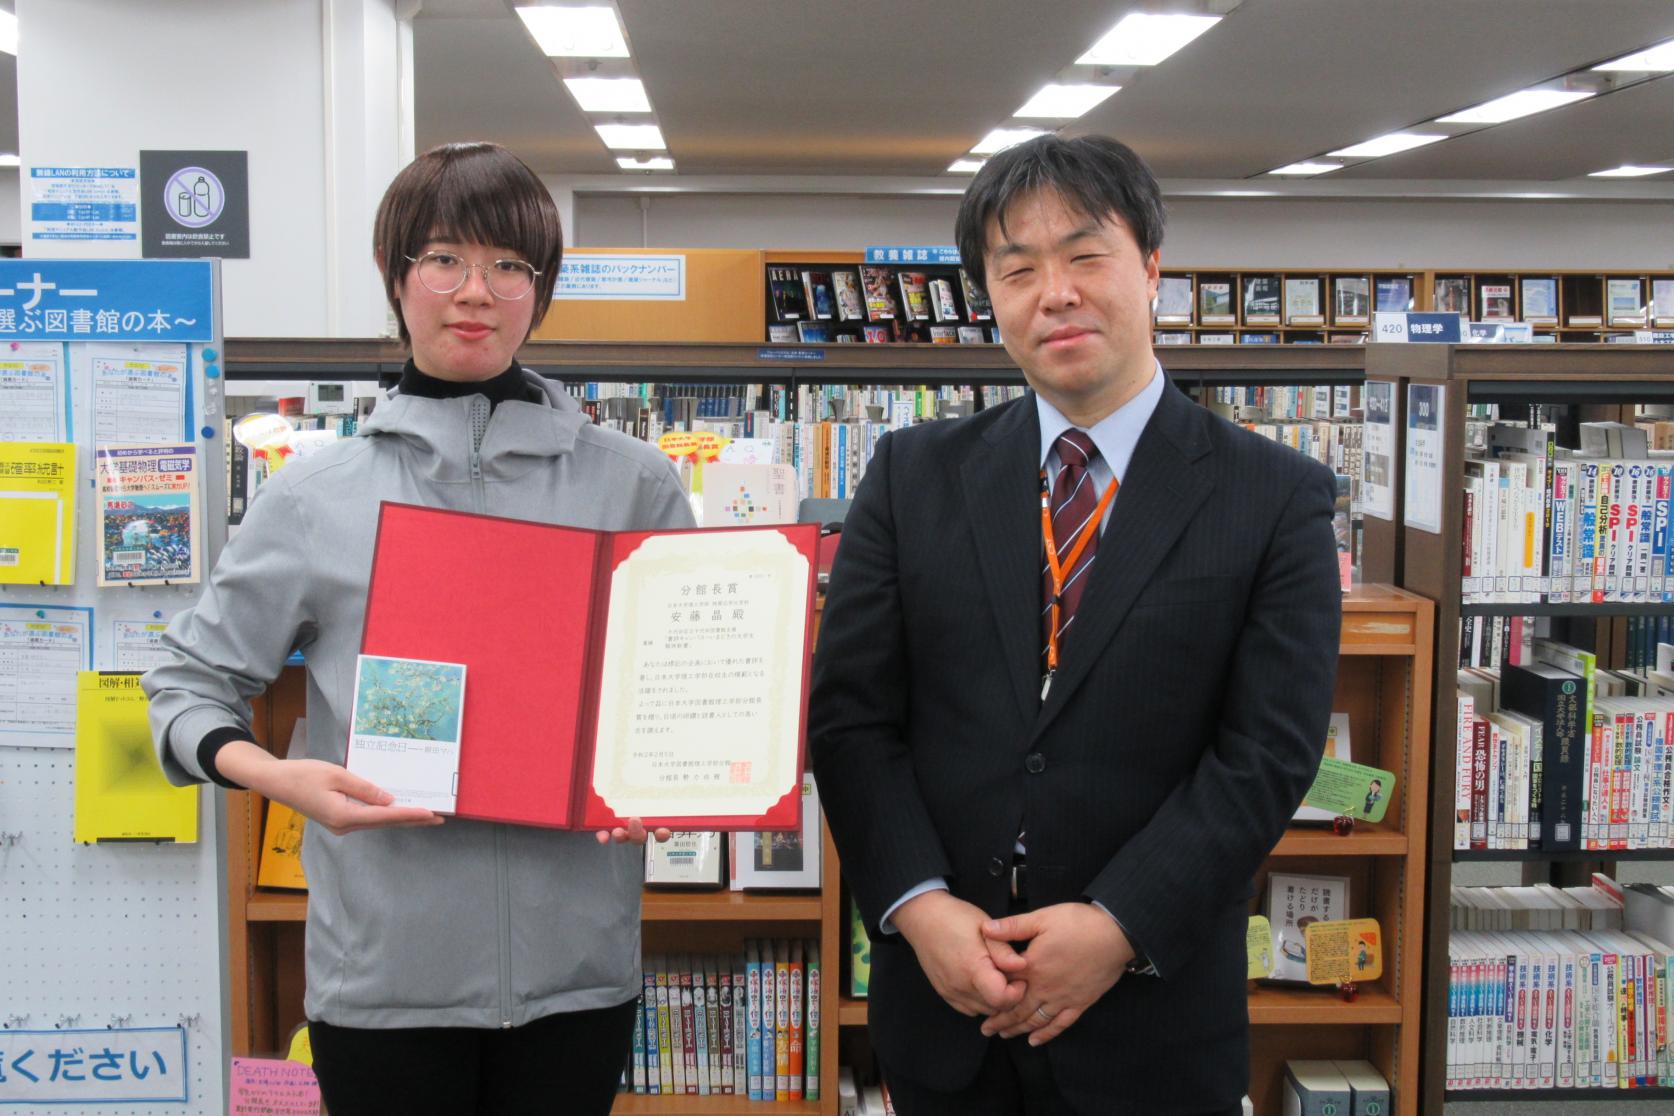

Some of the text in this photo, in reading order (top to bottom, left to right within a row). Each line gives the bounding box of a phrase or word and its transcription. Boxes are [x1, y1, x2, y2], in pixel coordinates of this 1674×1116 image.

[1381, 323, 1445, 335] 420 物理学
[1471, 328, 1487, 338] 化学
[1554, 501, 1565, 554] WEBテスト
[1599, 495, 1610, 534] 自己分析
[1608, 503, 1621, 542] SPI
[1625, 504, 1638, 542] SPI
[1656, 501, 1668, 547] SPI
[680, 583, 739, 596] 分館長賞
[1461, 704, 1473, 800] FIRE AND FURY
[1474, 750, 1487, 791] 恐怖の男
[1299, 886, 1307, 912] たどり
[1310, 887, 1319, 912] だけが
[1544, 1030, 1553, 1046] 化学
[237, 1065, 278, 1077] DEATH
